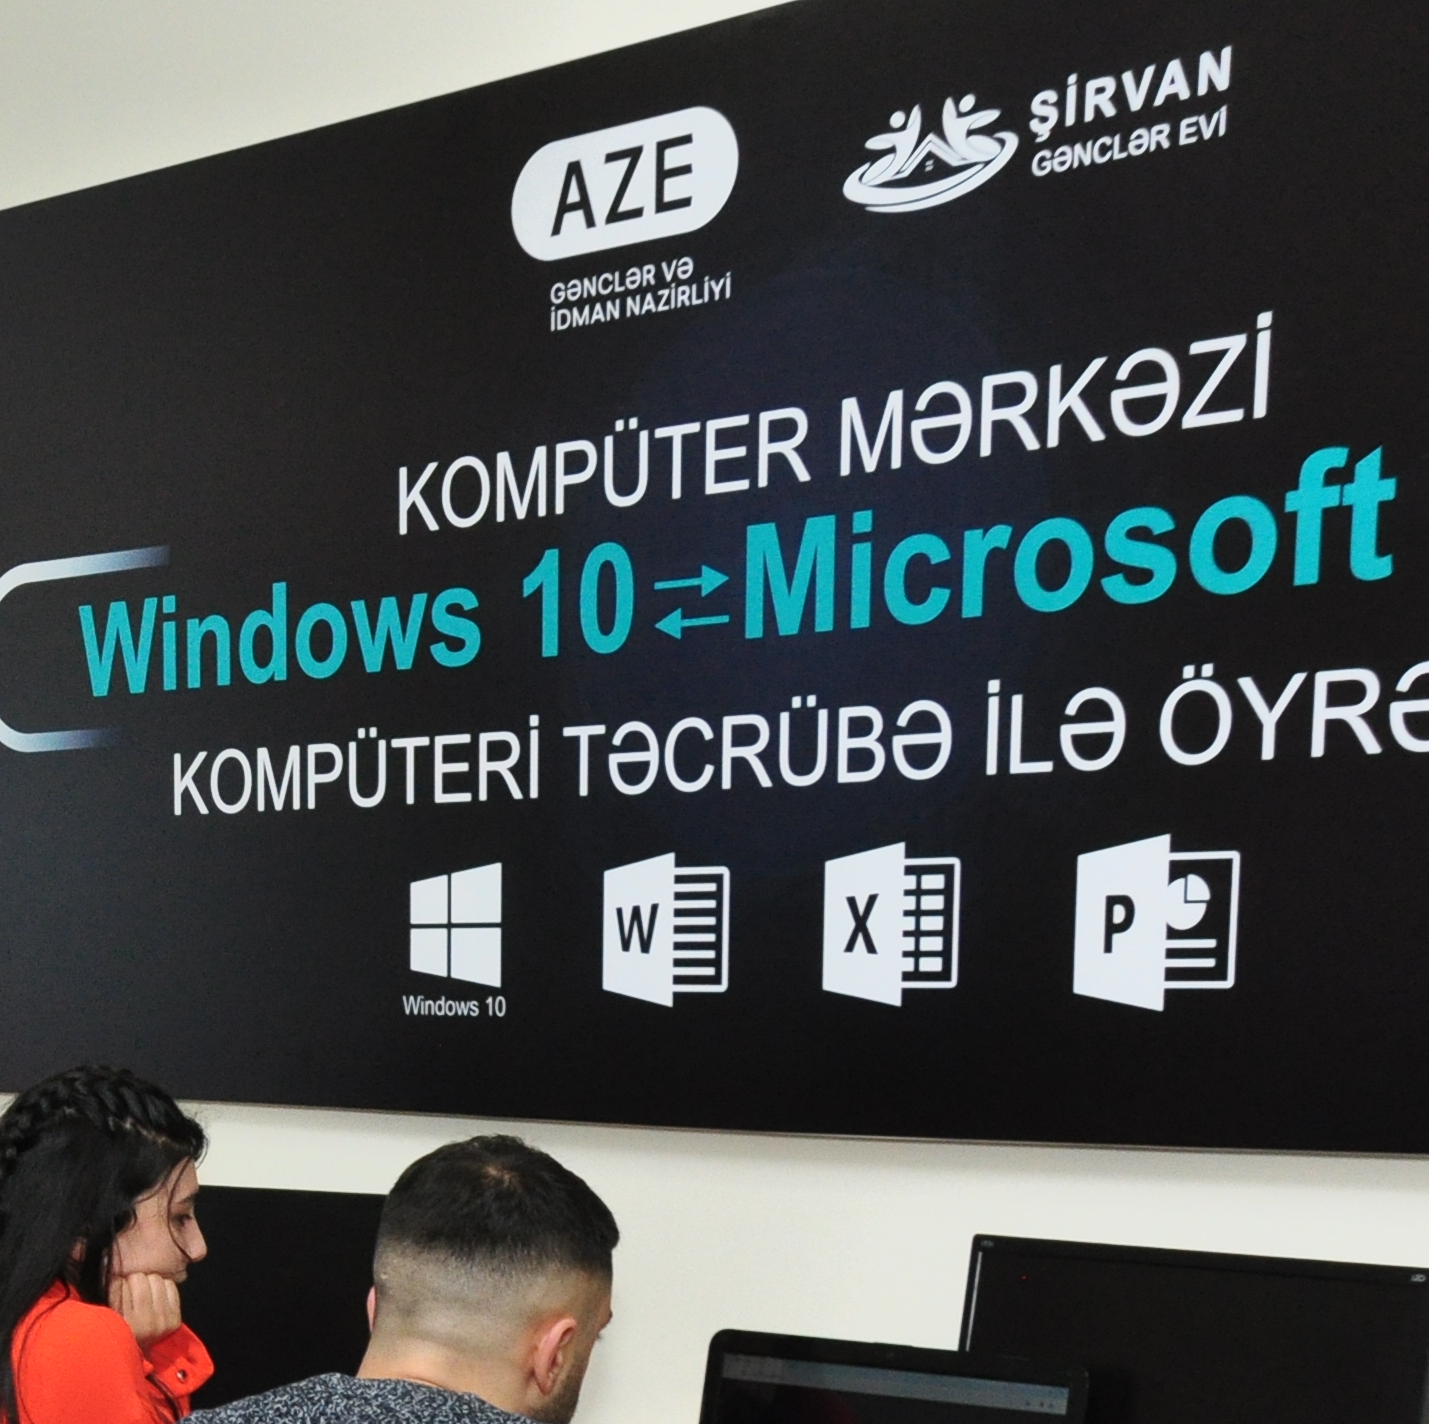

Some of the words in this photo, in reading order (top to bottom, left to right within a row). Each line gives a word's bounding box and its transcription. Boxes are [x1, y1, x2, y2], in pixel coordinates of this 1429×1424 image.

[1029, 46, 1233, 142] ŞİRVAN
[1032, 122, 1171, 177] GƏNCLƏR
[1179, 104, 1228, 146] EVİ
[551, 133, 693, 237] AZE
[550, 266, 657, 305] GƏNCLƏR
[662, 256, 694, 282] VƏ
[550, 298, 621, 332] İDMAN
[626, 271, 732, 318] NAZİRLİYİ
[398, 406, 812, 536] KOMPÜTER
[839, 310, 1273, 477] MƏRKƏZİ
[78, 587, 481, 698] Windows
[522, 541, 635, 658] 10
[744, 446, 1397, 640] Microsoft
[173, 714, 540, 816] KOMPÜTERİ
[562, 694, 953, 797] TƏCRÜBƏ
[985, 678, 1127, 776] İLƏ
[616, 903, 659, 954] W
[844, 893, 878, 955] X
[1104, 894, 1135, 954] P
[402, 995, 480, 1017] Windows
[485, 995, 507, 1018] 10
